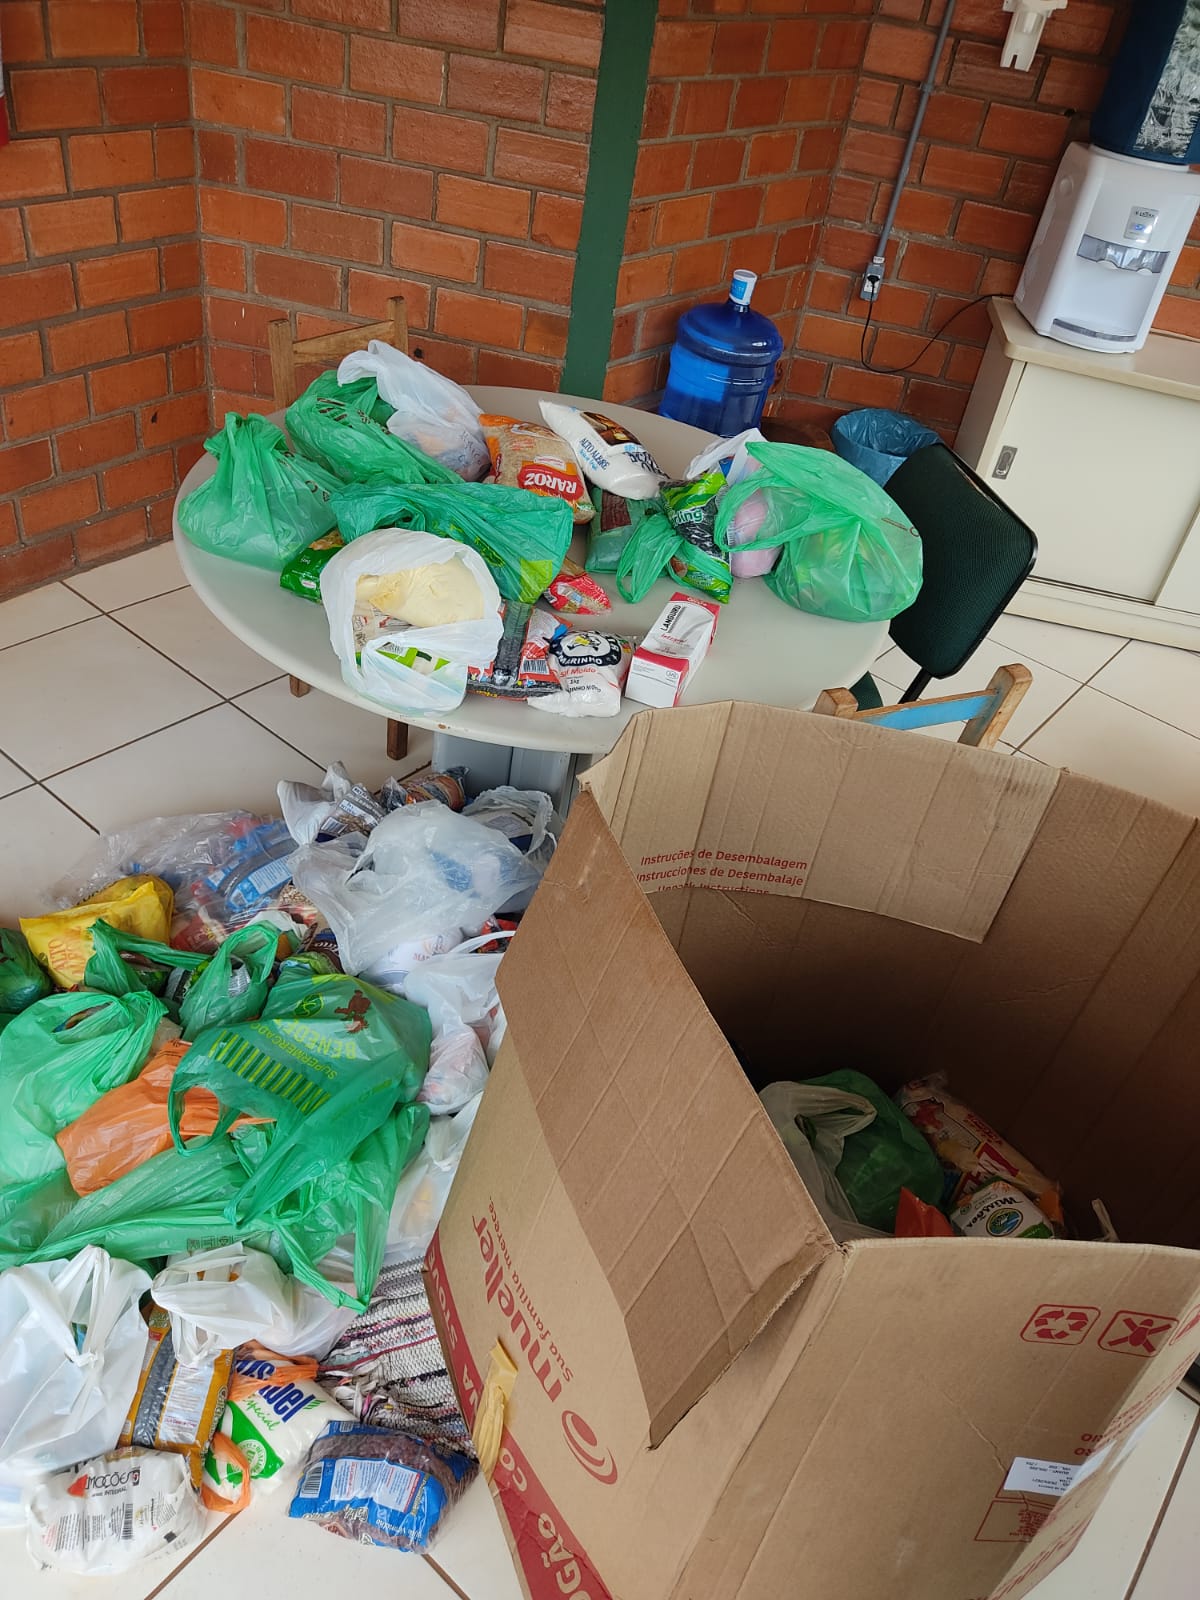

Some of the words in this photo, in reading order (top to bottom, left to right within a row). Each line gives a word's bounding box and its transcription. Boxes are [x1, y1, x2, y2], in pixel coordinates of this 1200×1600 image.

[580, 437, 595, 453] ALTO
[523, 472, 577, 494] RAROZ
[660, 604, 682, 632] LANGUIRU
[640, 849, 695, 867] Instruções
[697, 849, 713, 860] de
[716, 850, 808, 871] Desembalagem
[636, 866, 706, 883] Instrucciones
[709, 866, 724, 877] de
[727, 869, 804, 887] Desembalaje
[472, 1215, 562, 1403] mueller
